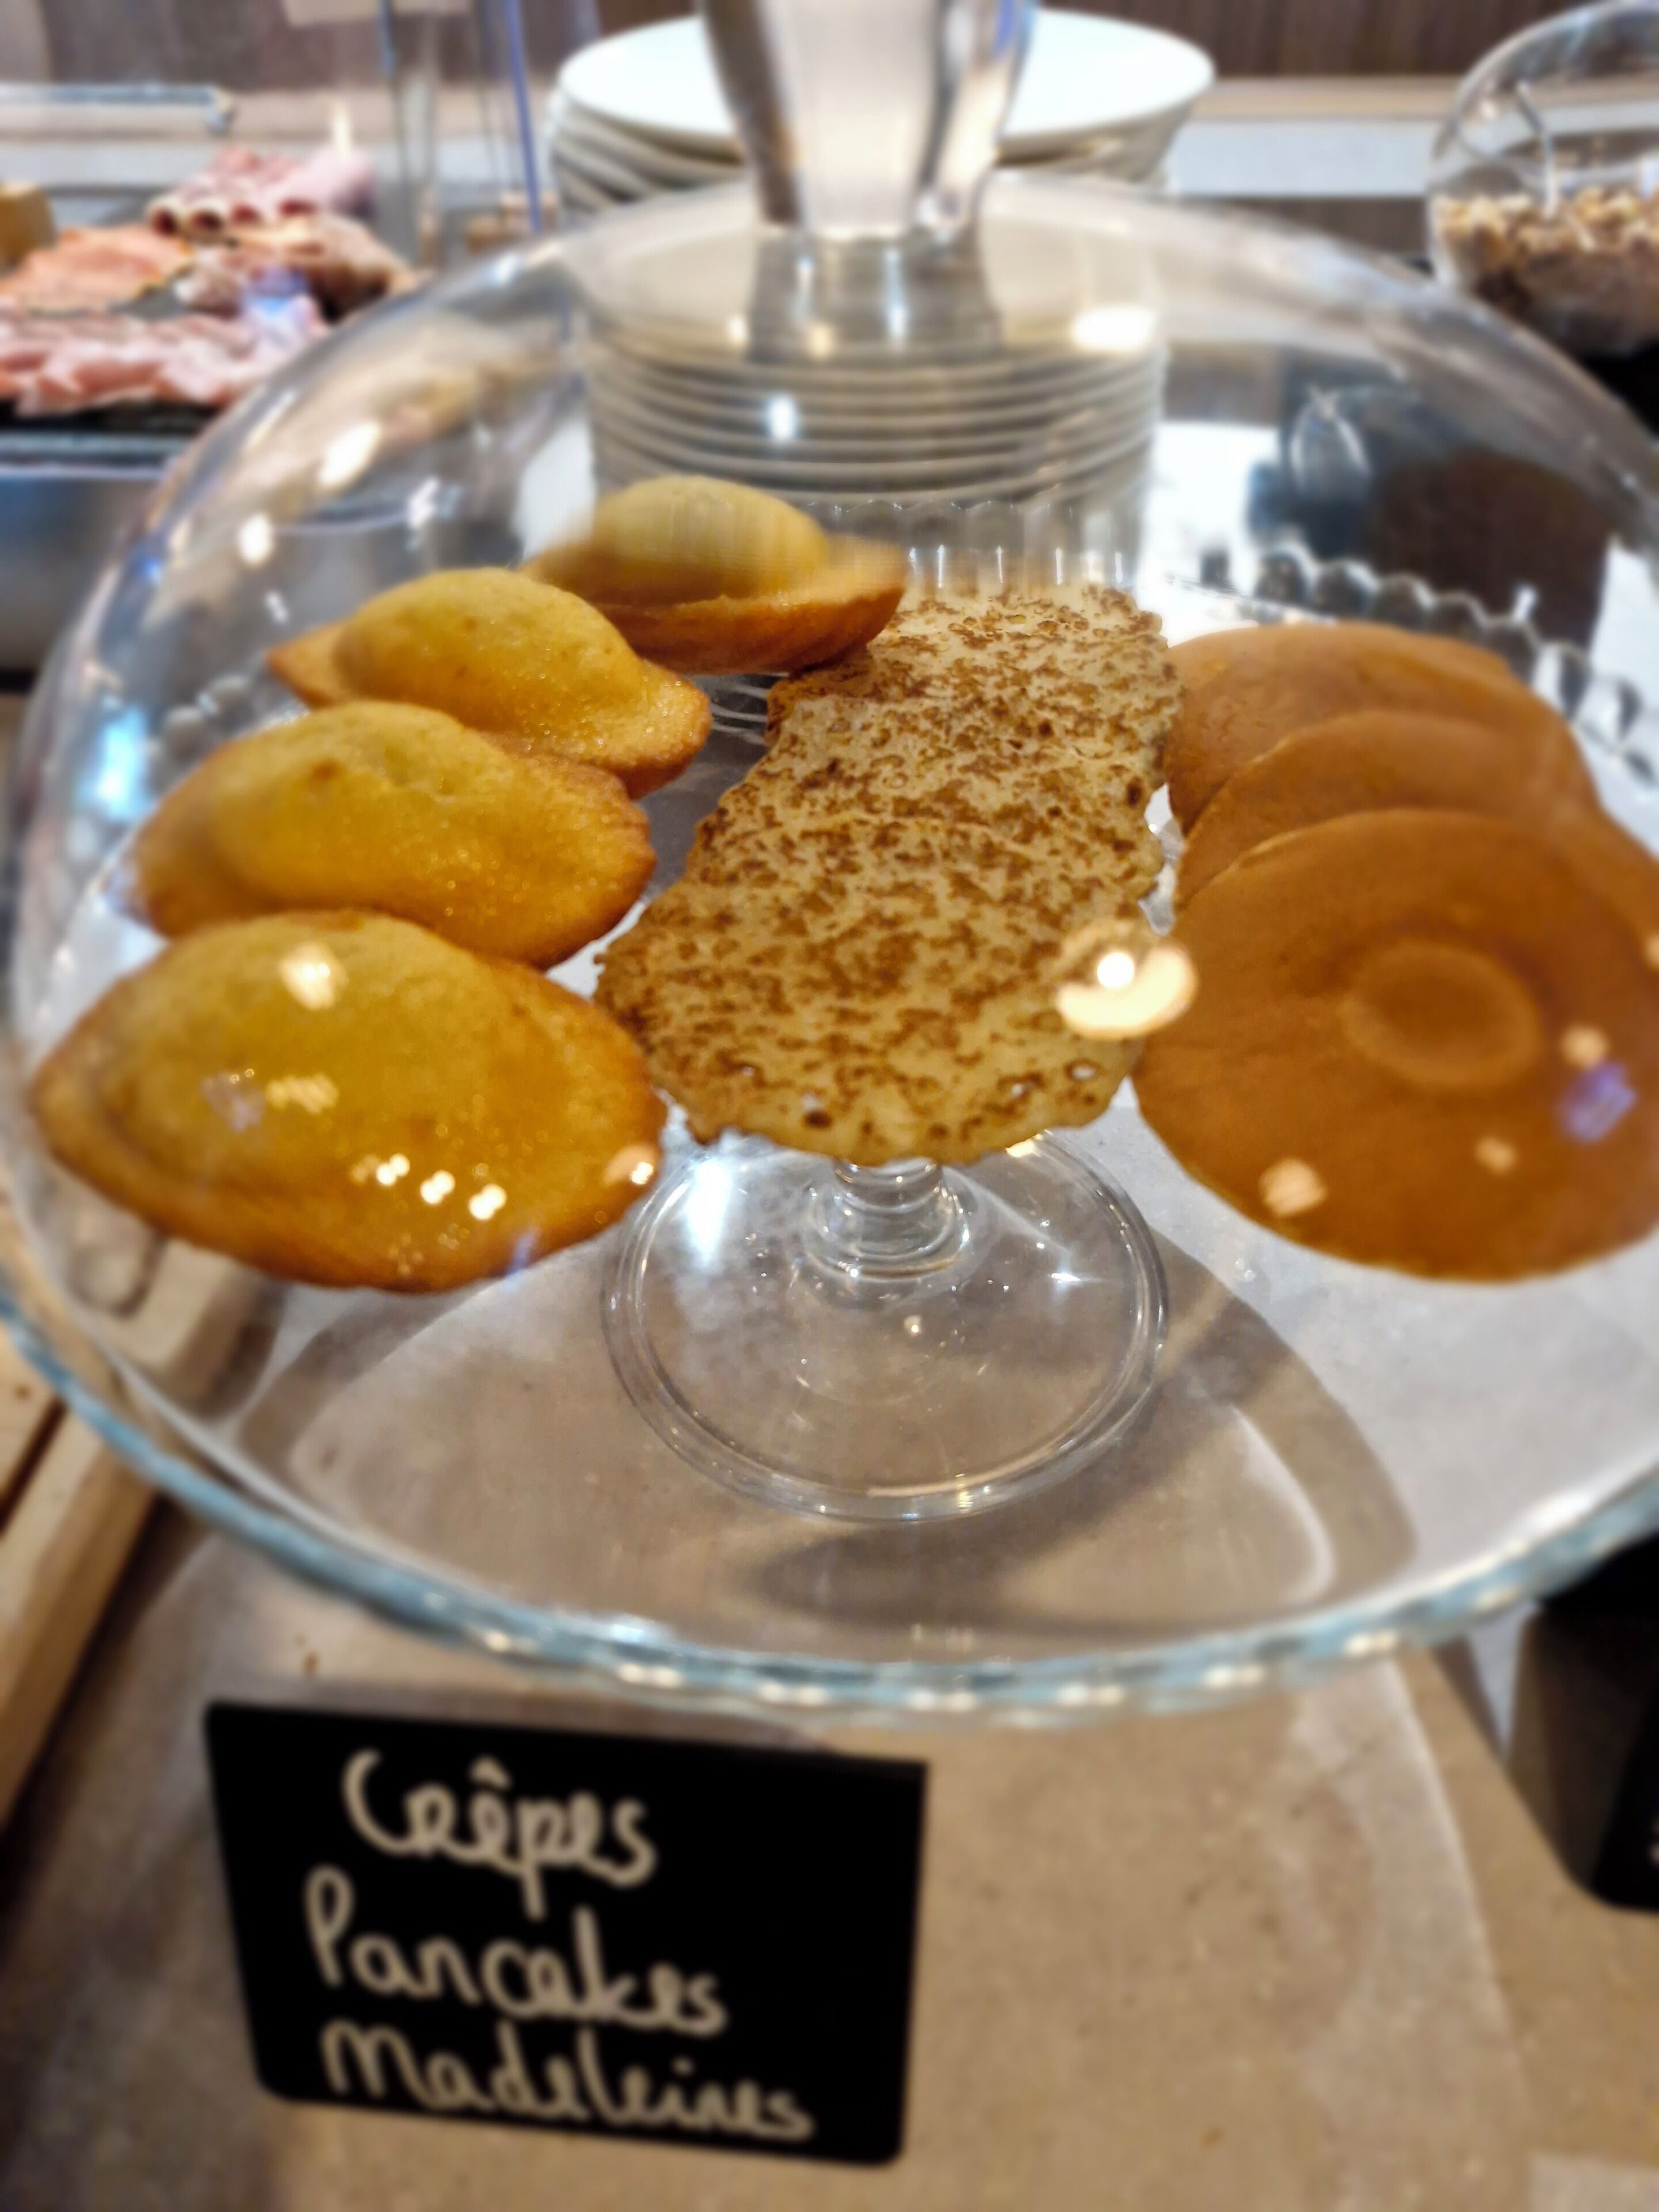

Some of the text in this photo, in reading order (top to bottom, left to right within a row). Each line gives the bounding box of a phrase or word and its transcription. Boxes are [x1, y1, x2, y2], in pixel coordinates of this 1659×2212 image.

[343, 1749, 657, 1920] Crêpes
[305, 1865, 728, 2036] Pancakes
[321, 2021, 814, 2139] Madeleines
